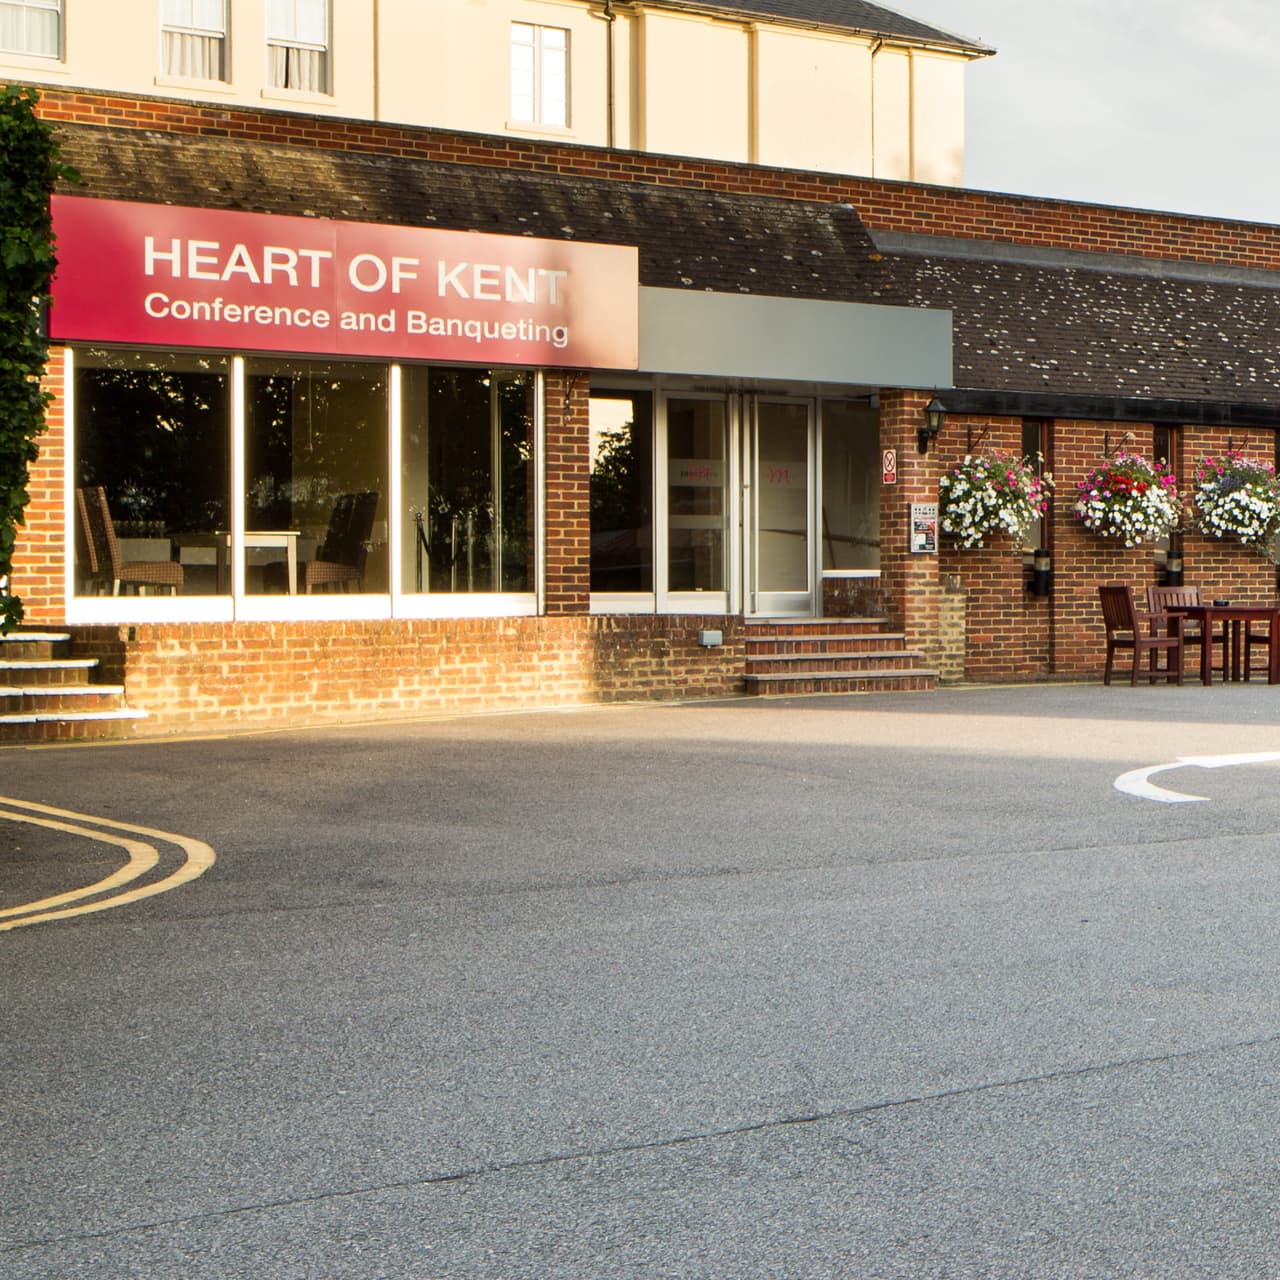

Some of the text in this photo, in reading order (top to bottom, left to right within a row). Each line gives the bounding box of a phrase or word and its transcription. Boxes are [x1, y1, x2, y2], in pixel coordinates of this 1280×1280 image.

[144, 236, 568, 305] HEART OF KENT
[144, 292, 568, 348] Conference and Banqueting
